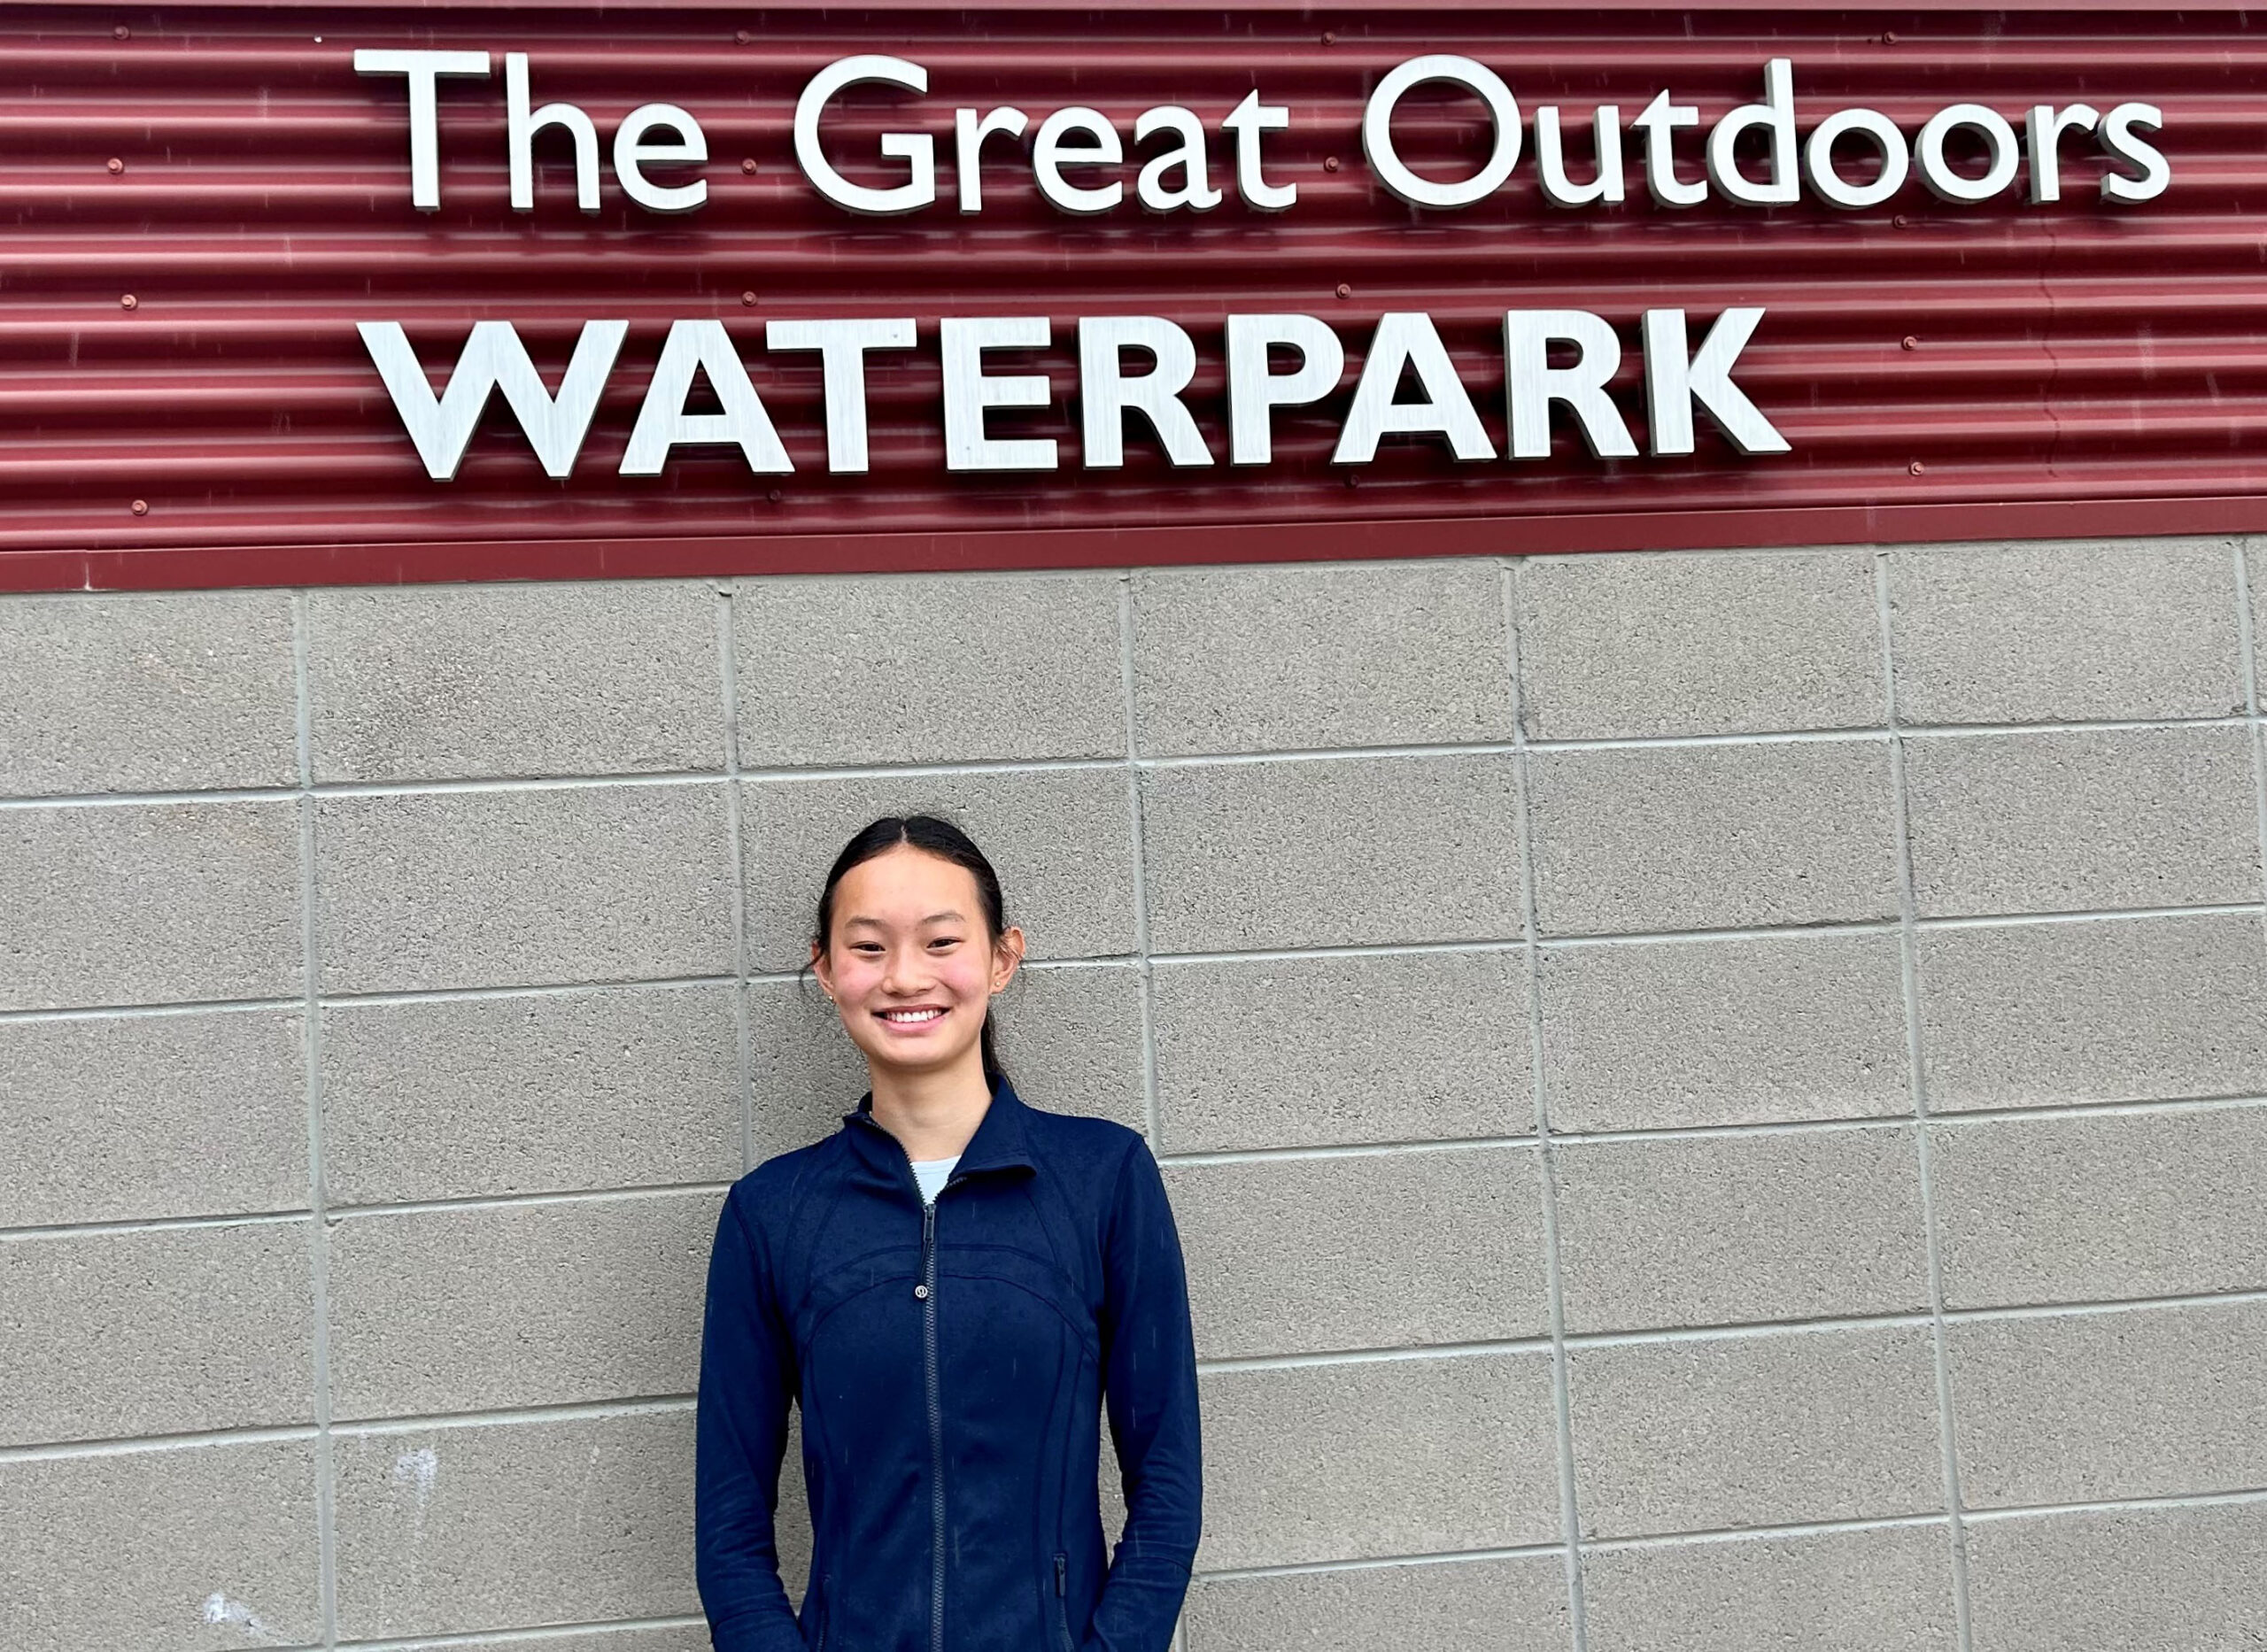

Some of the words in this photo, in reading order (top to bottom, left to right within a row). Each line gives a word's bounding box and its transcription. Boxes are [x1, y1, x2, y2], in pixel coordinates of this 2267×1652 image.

[354, 50, 709, 211] The
[794, 54, 1298, 212] Great
[1364, 55, 2171, 208] Outdoors
[357, 306, 1792, 480] WATERPARK
